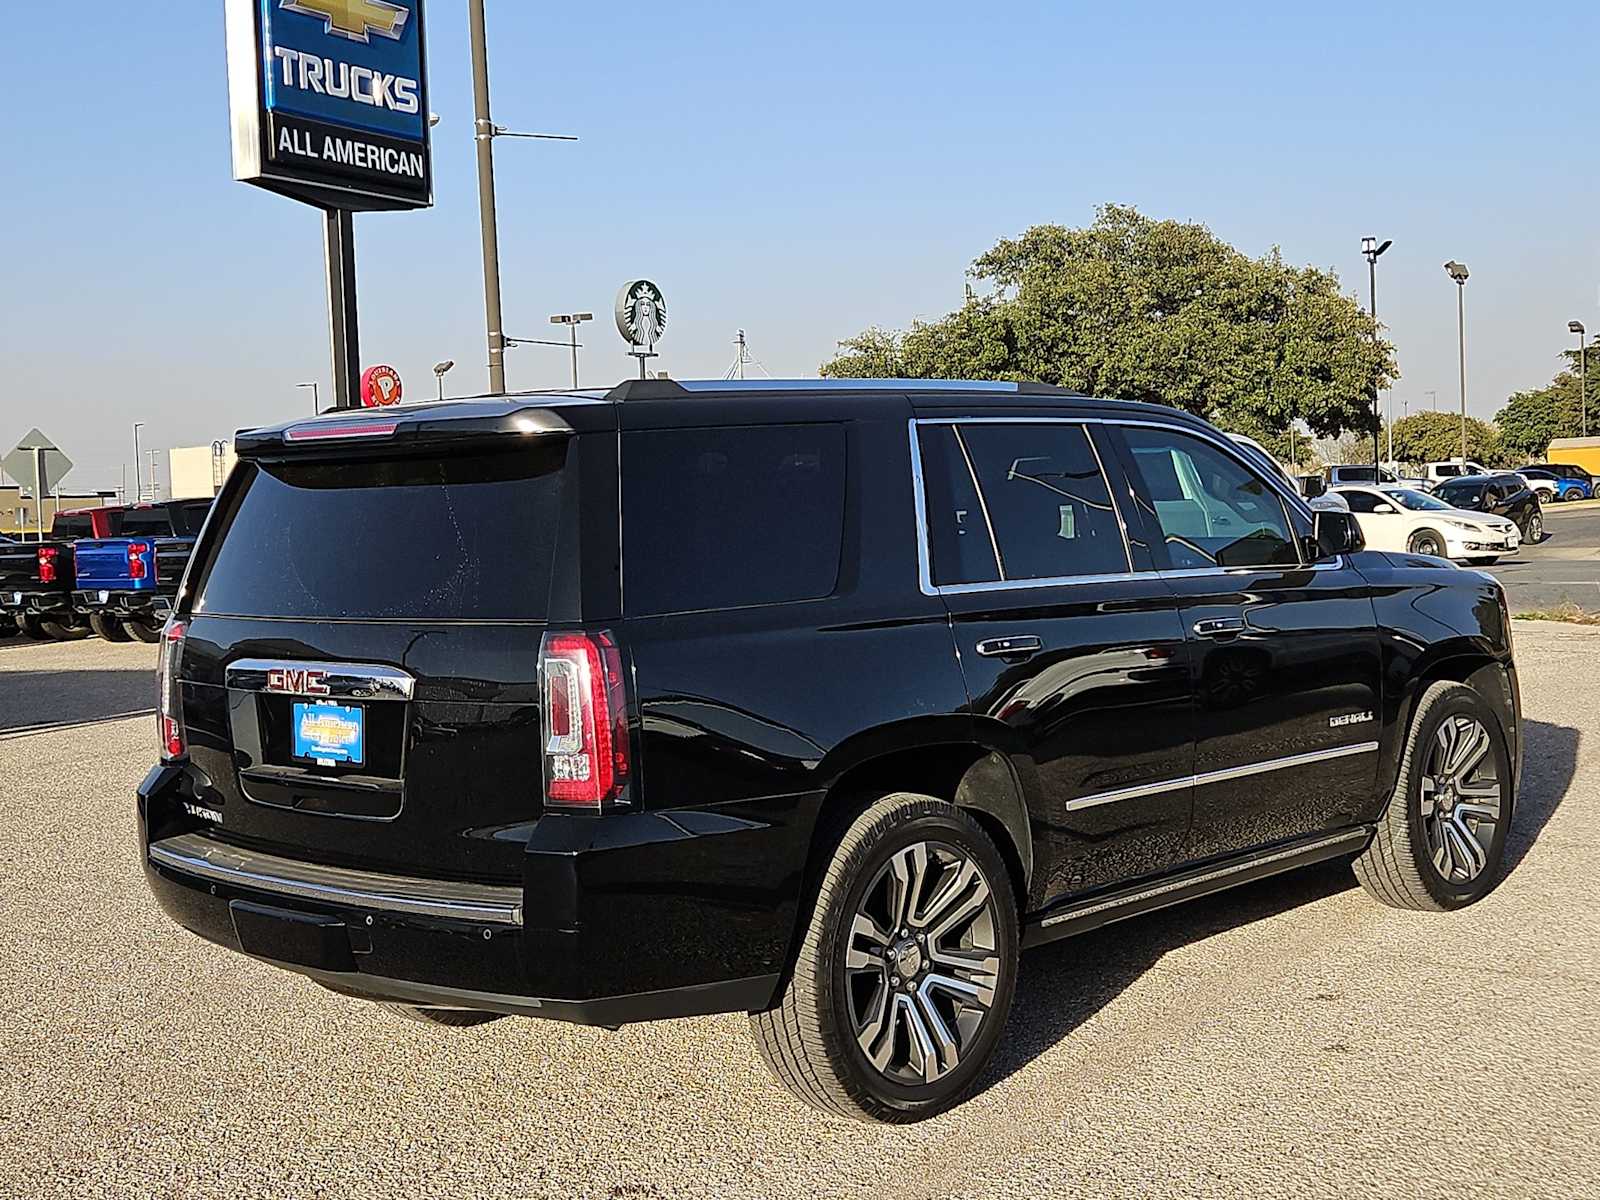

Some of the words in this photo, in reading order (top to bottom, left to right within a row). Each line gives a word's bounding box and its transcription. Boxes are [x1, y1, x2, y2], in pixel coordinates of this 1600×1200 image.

[274, 45, 419, 114] TRUCKS
[278, 126, 319, 158] ALL
[322, 135, 424, 178] AMERICAN
[267, 669, 330, 695] GMC
[1329, 711, 1374, 728] DENALI
